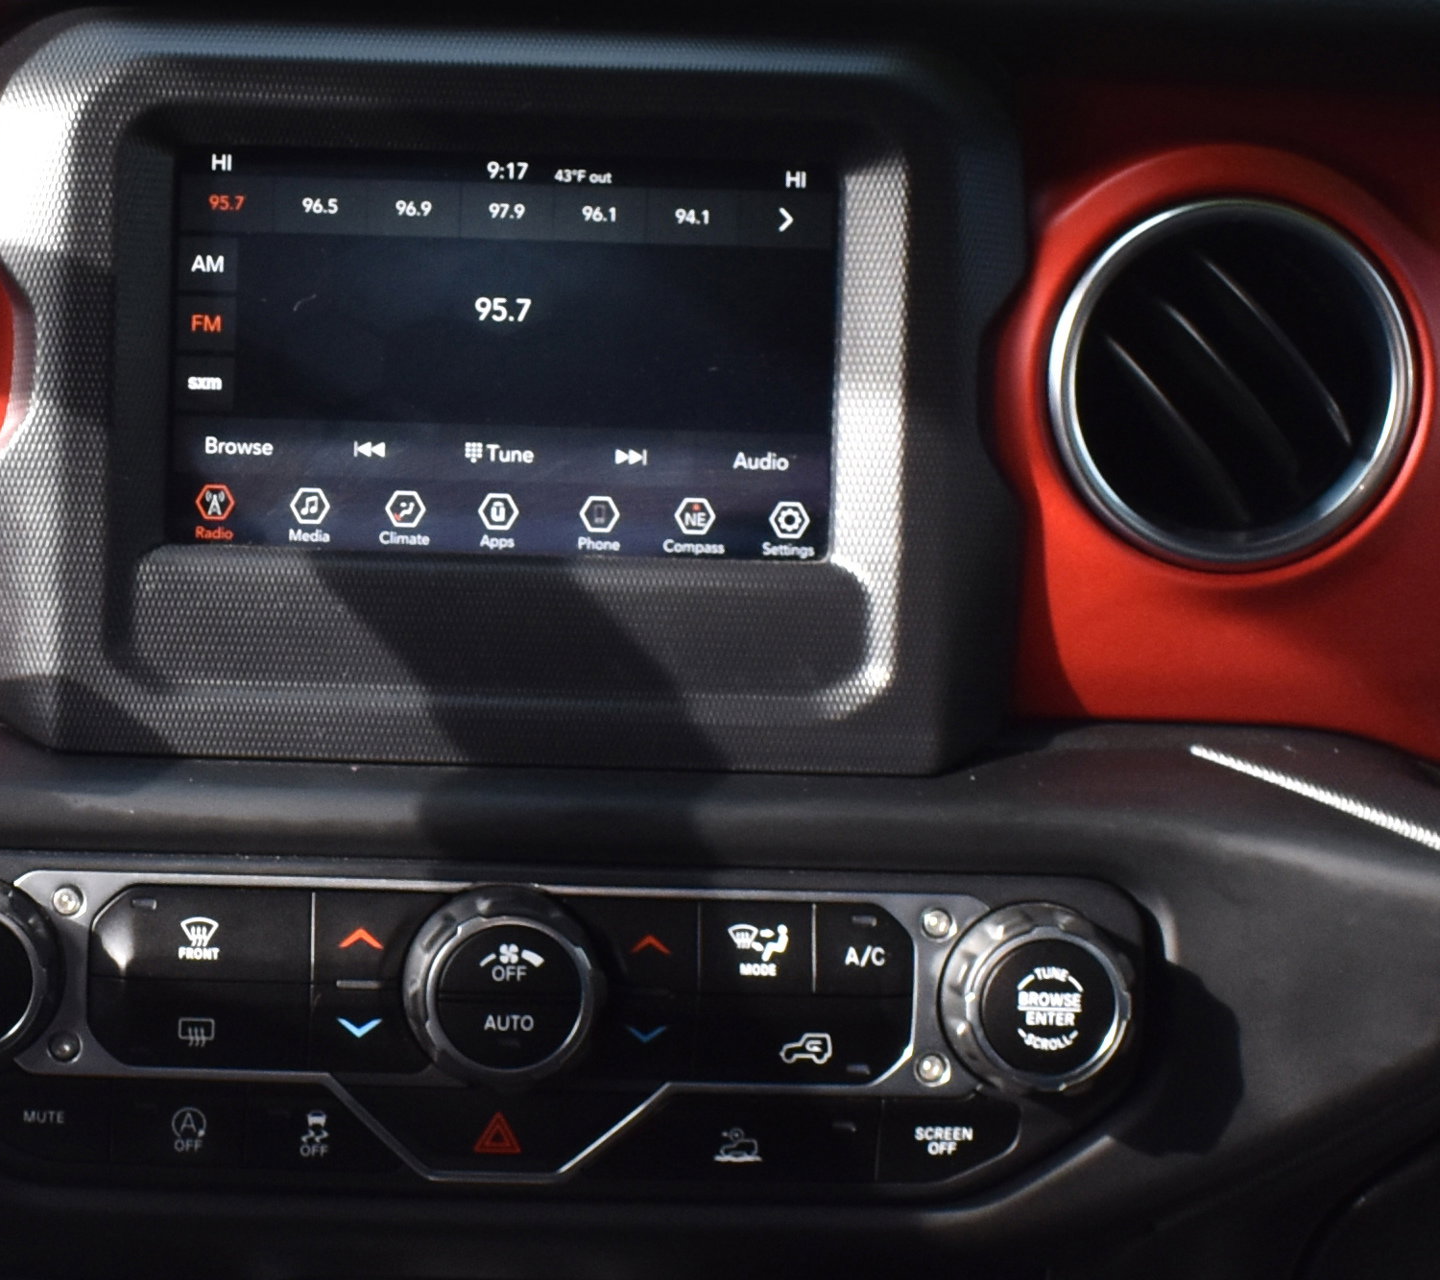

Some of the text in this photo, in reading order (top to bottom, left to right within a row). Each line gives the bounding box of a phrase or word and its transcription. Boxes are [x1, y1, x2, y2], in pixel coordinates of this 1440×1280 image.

[210, 154, 233, 171] HI
[486, 161, 613, 184] 9:17 43°F out
[784, 171, 808, 188] HI
[208, 194, 711, 226] 95.7 96.5 96.9 97.9 96.1 94.1
[191, 254, 225, 273] AM
[473, 296, 533, 324] 95.7
[191, 314, 223, 333] FM
[203, 436, 274, 456] Browse
[487, 444, 535, 465] Tune
[733, 450, 790, 472] Audio
[683, 512, 708, 528] NE
[194, 524, 816, 560] Radio Media Climate Apps Phone Compass Settings
[178, 946, 220, 961] FRONT
[844, 945, 886, 969] A/C
[491, 965, 528, 983] OFF
[739, 962, 777, 978] MODE
[1034, 966, 1070, 983] TUNE
[1018, 991, 1082, 1008] BROWSE
[483, 1014, 534, 1032] AUTO
[1025, 1010, 1076, 1027] ENTER
[1024, 1032, 1074, 1051] SCROLL
[22, 1109, 66, 1125] MUTE
[914, 1126, 974, 1143] SCREEN
[173, 1138, 203, 1153] OFF
[298, 1143, 329, 1158] OFF
[927, 1142, 957, 1156] OFF
